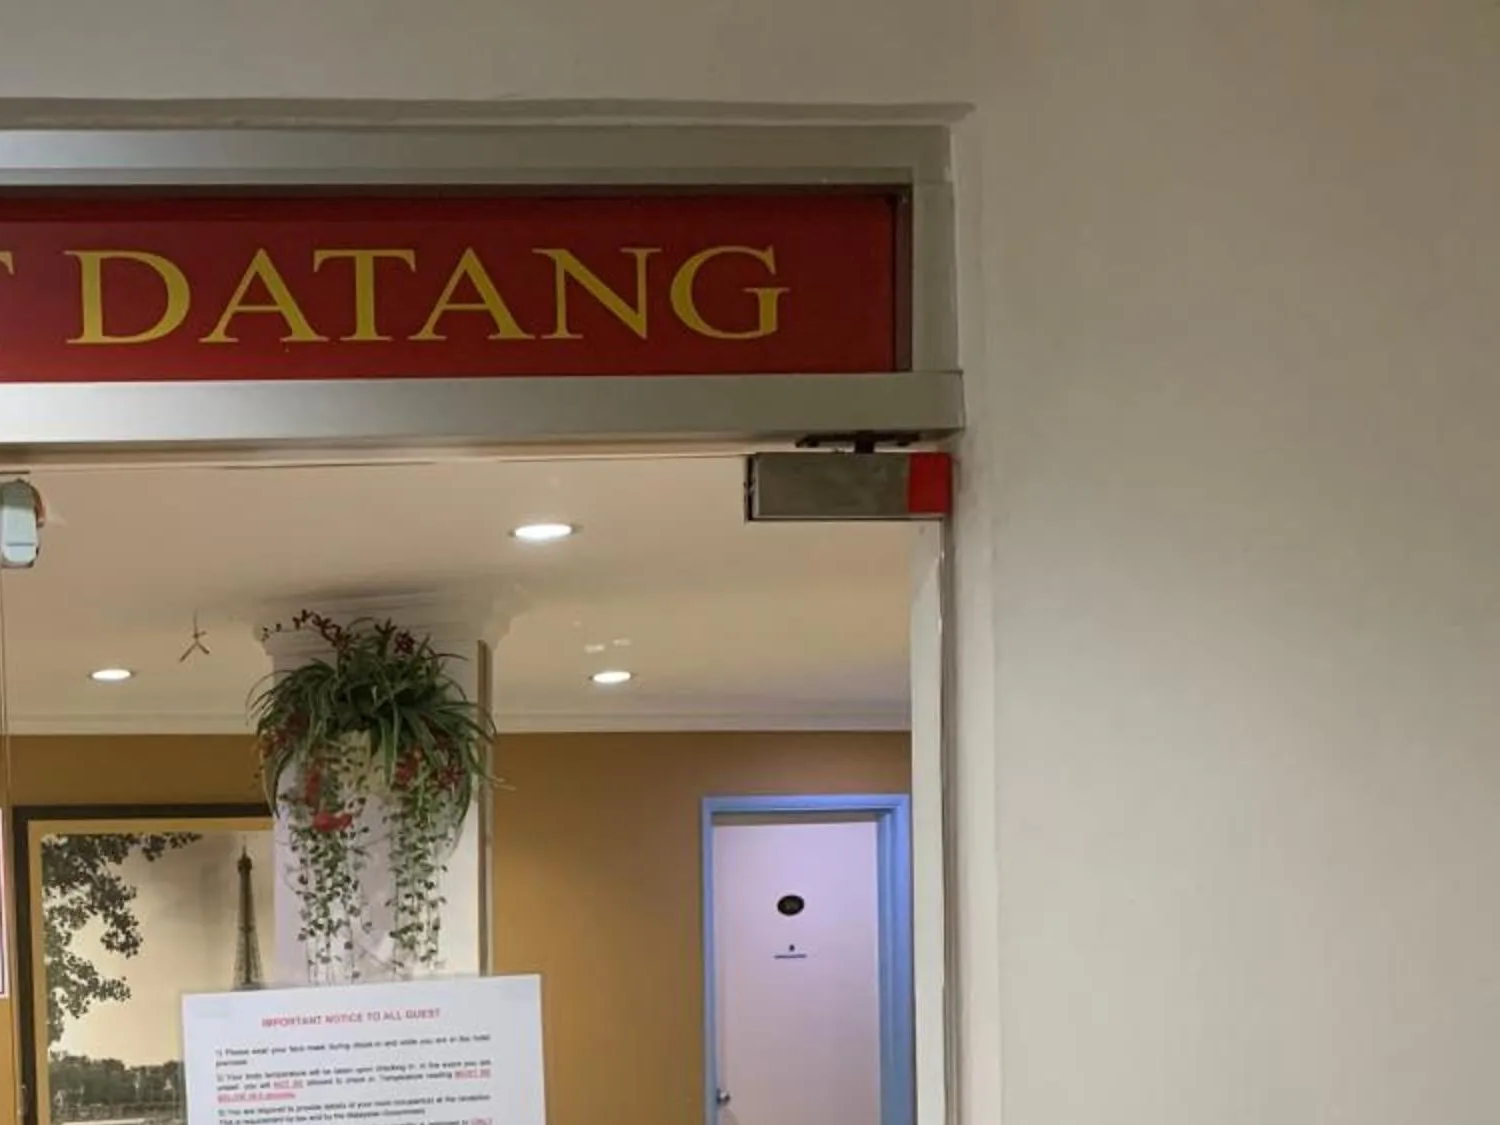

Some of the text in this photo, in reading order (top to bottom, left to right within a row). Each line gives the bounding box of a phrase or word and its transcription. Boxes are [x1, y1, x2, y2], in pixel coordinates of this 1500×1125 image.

[65, 245, 790, 346] DATANG
[262, 1015, 321, 1028] IMPORTANT
[325, 1012, 363, 1025] NOTICE
[367, 1011, 381, 1022] TO
[383, 1010, 402, 1021] ALL
